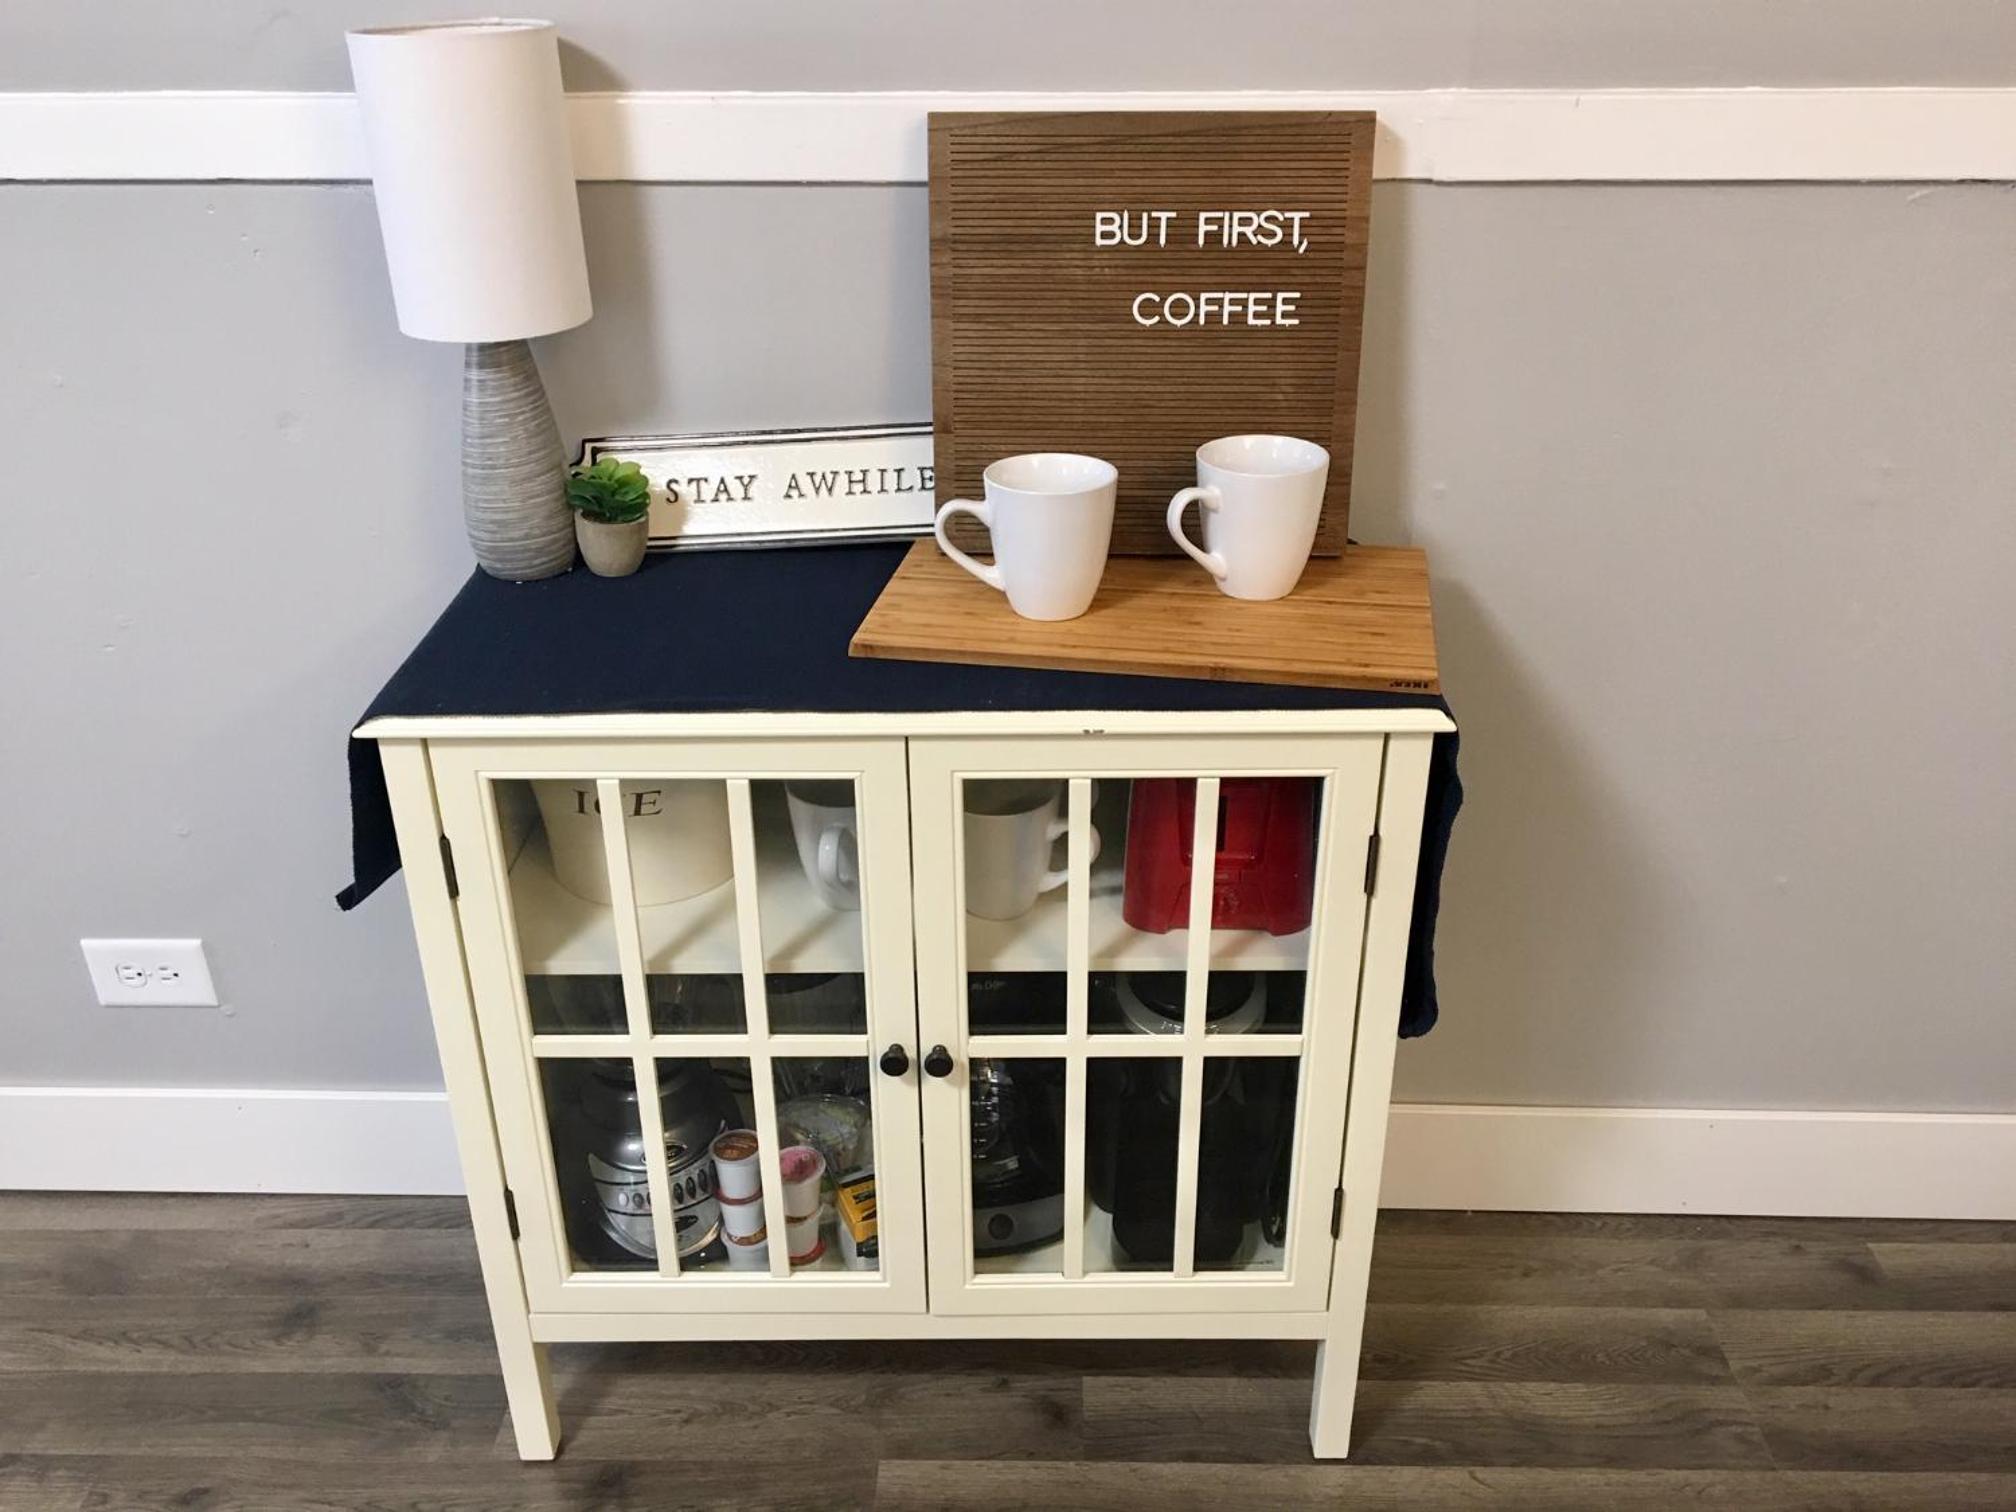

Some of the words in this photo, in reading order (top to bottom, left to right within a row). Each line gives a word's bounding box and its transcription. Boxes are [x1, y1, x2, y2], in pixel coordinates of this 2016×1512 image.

[1095, 210, 1177, 248] BUT
[1198, 209, 1310, 254] FIRST,
[1132, 292, 1301, 327] COFFEE
[665, 474, 759, 504] STAY
[783, 466, 934, 499] AWHILE
[573, 788, 662, 817] IE
